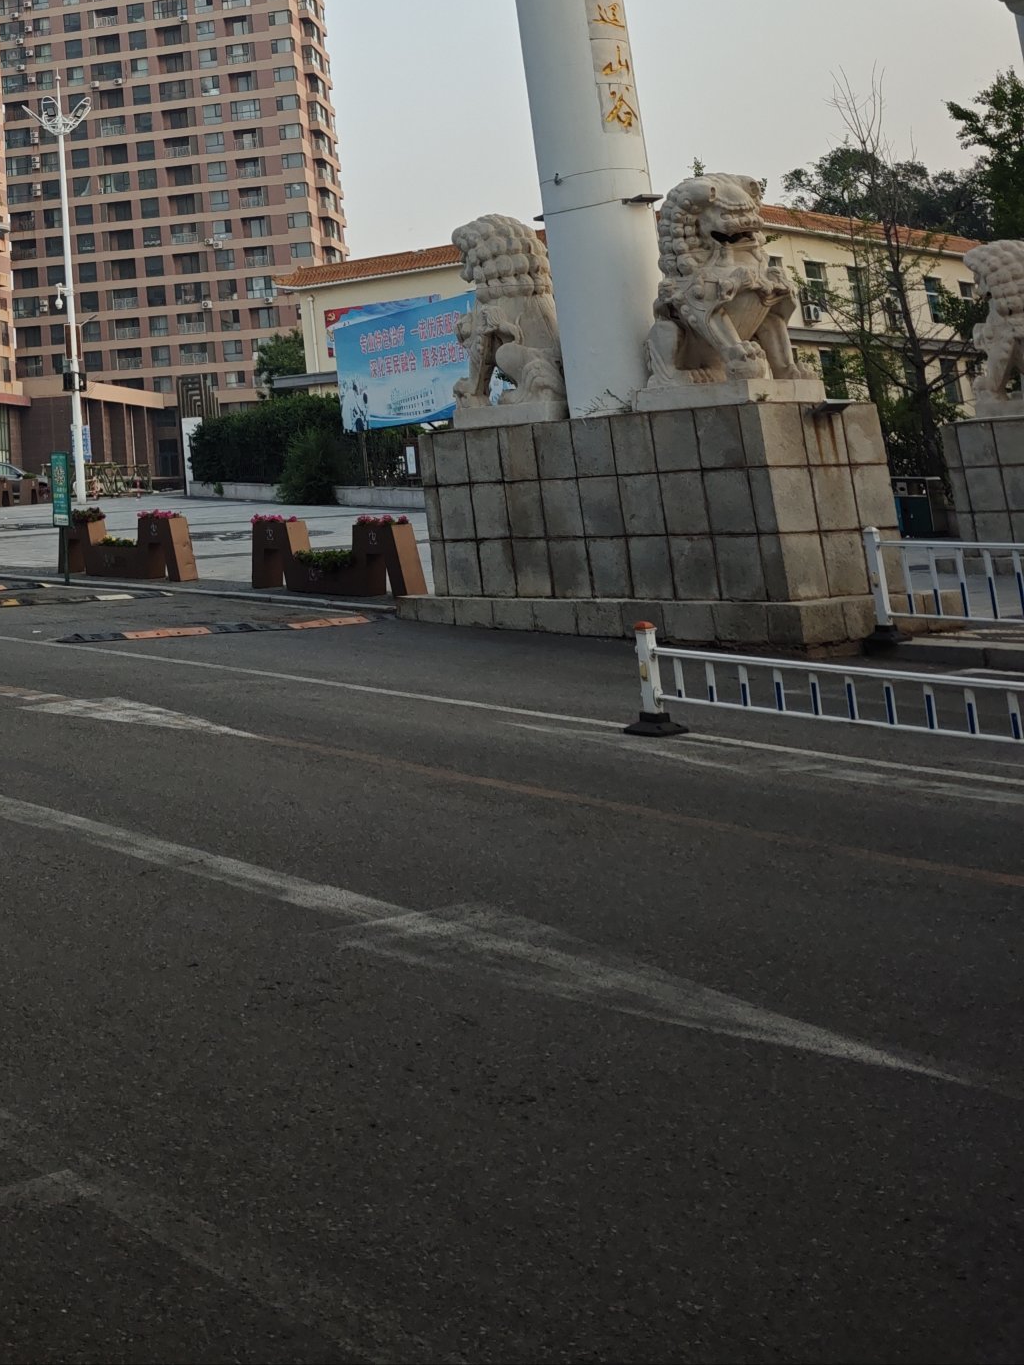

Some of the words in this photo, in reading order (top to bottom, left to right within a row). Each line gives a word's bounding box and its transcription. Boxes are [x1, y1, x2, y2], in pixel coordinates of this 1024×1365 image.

[422, 342, 470, 368] 服务驻地百
